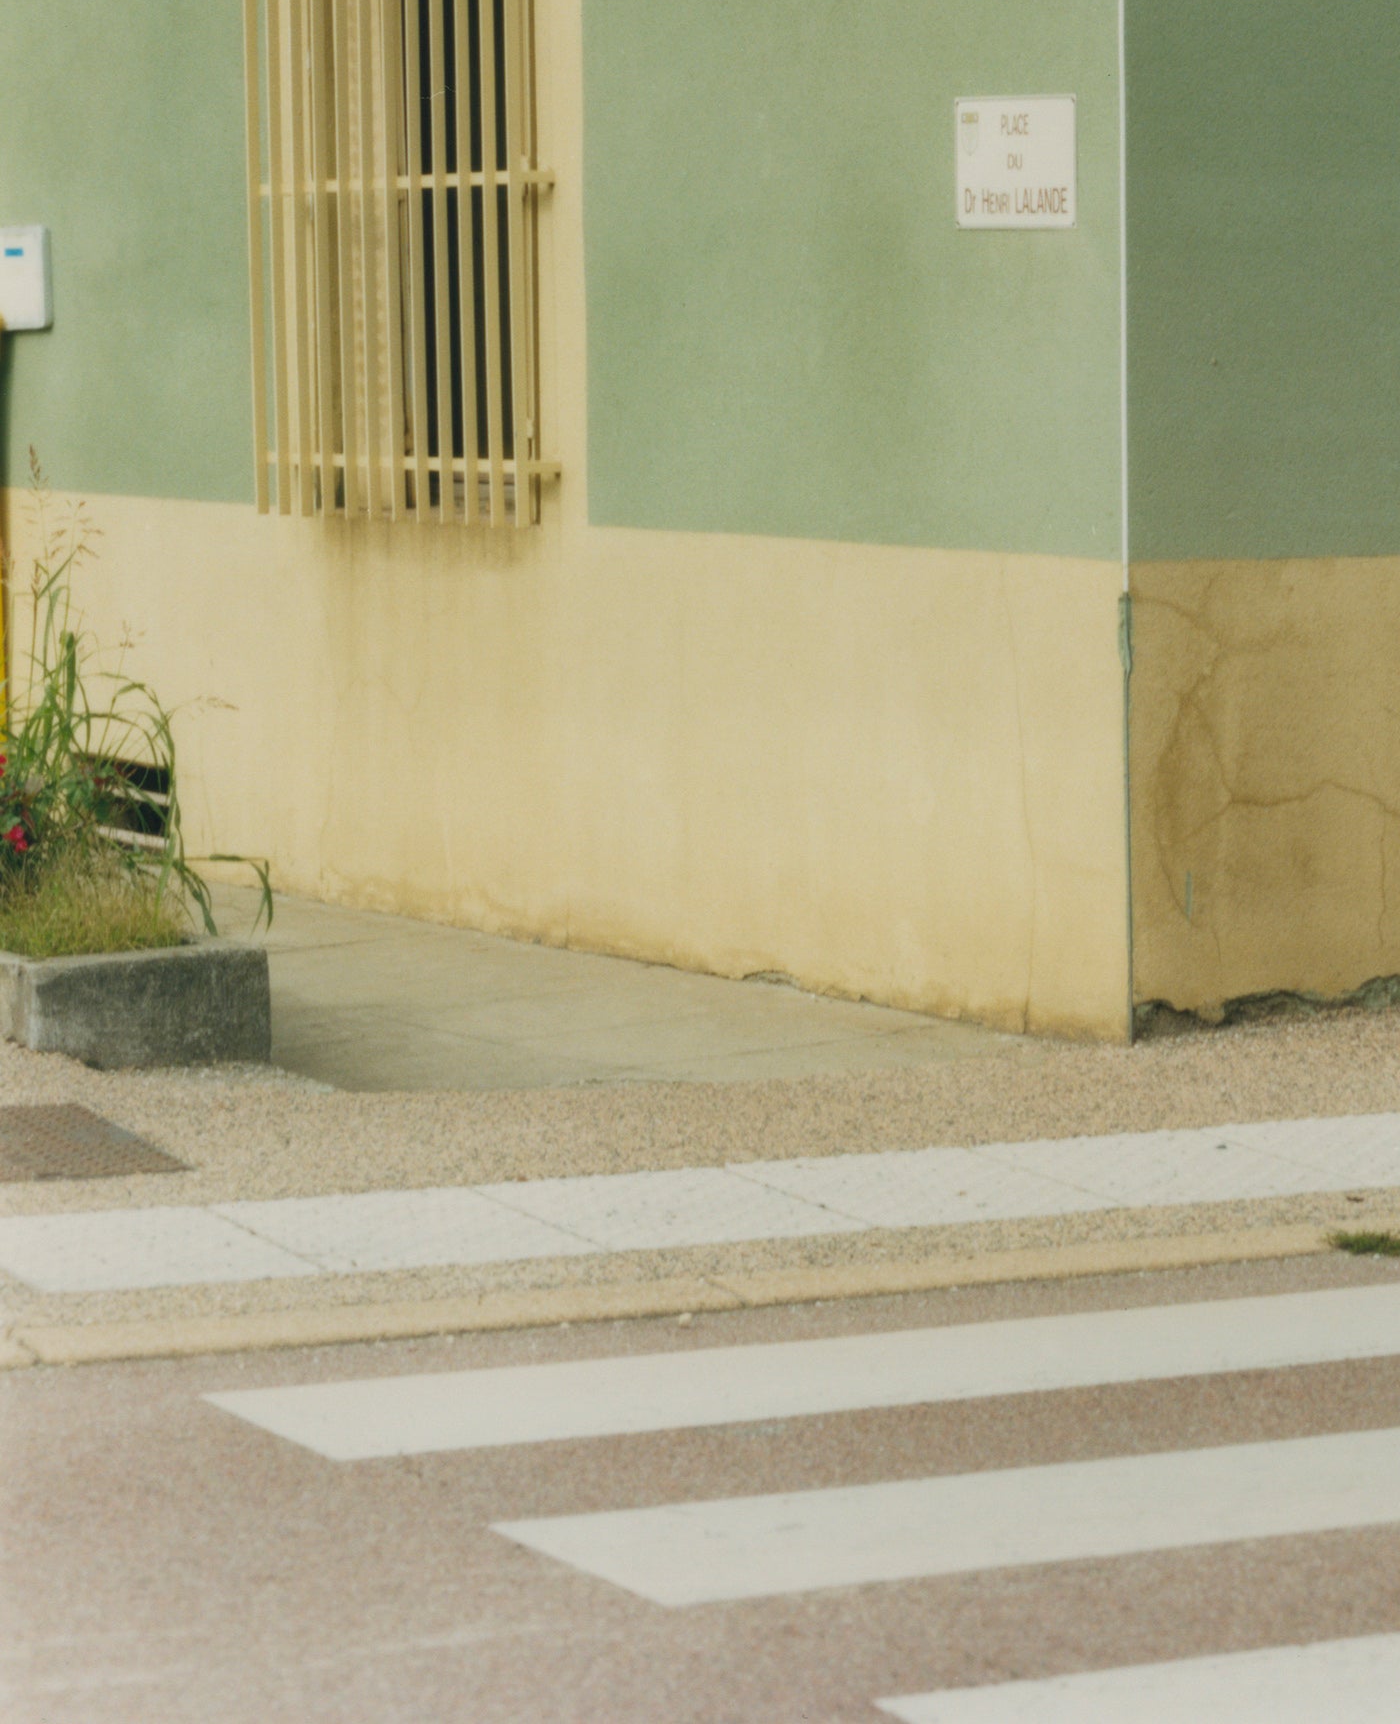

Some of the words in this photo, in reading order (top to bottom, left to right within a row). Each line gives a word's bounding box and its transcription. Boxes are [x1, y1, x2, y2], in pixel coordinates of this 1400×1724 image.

[1000, 113, 1030, 135] PLACE
[1007, 153, 1023, 170] DU
[1015, 187, 1068, 214] LALANDE
